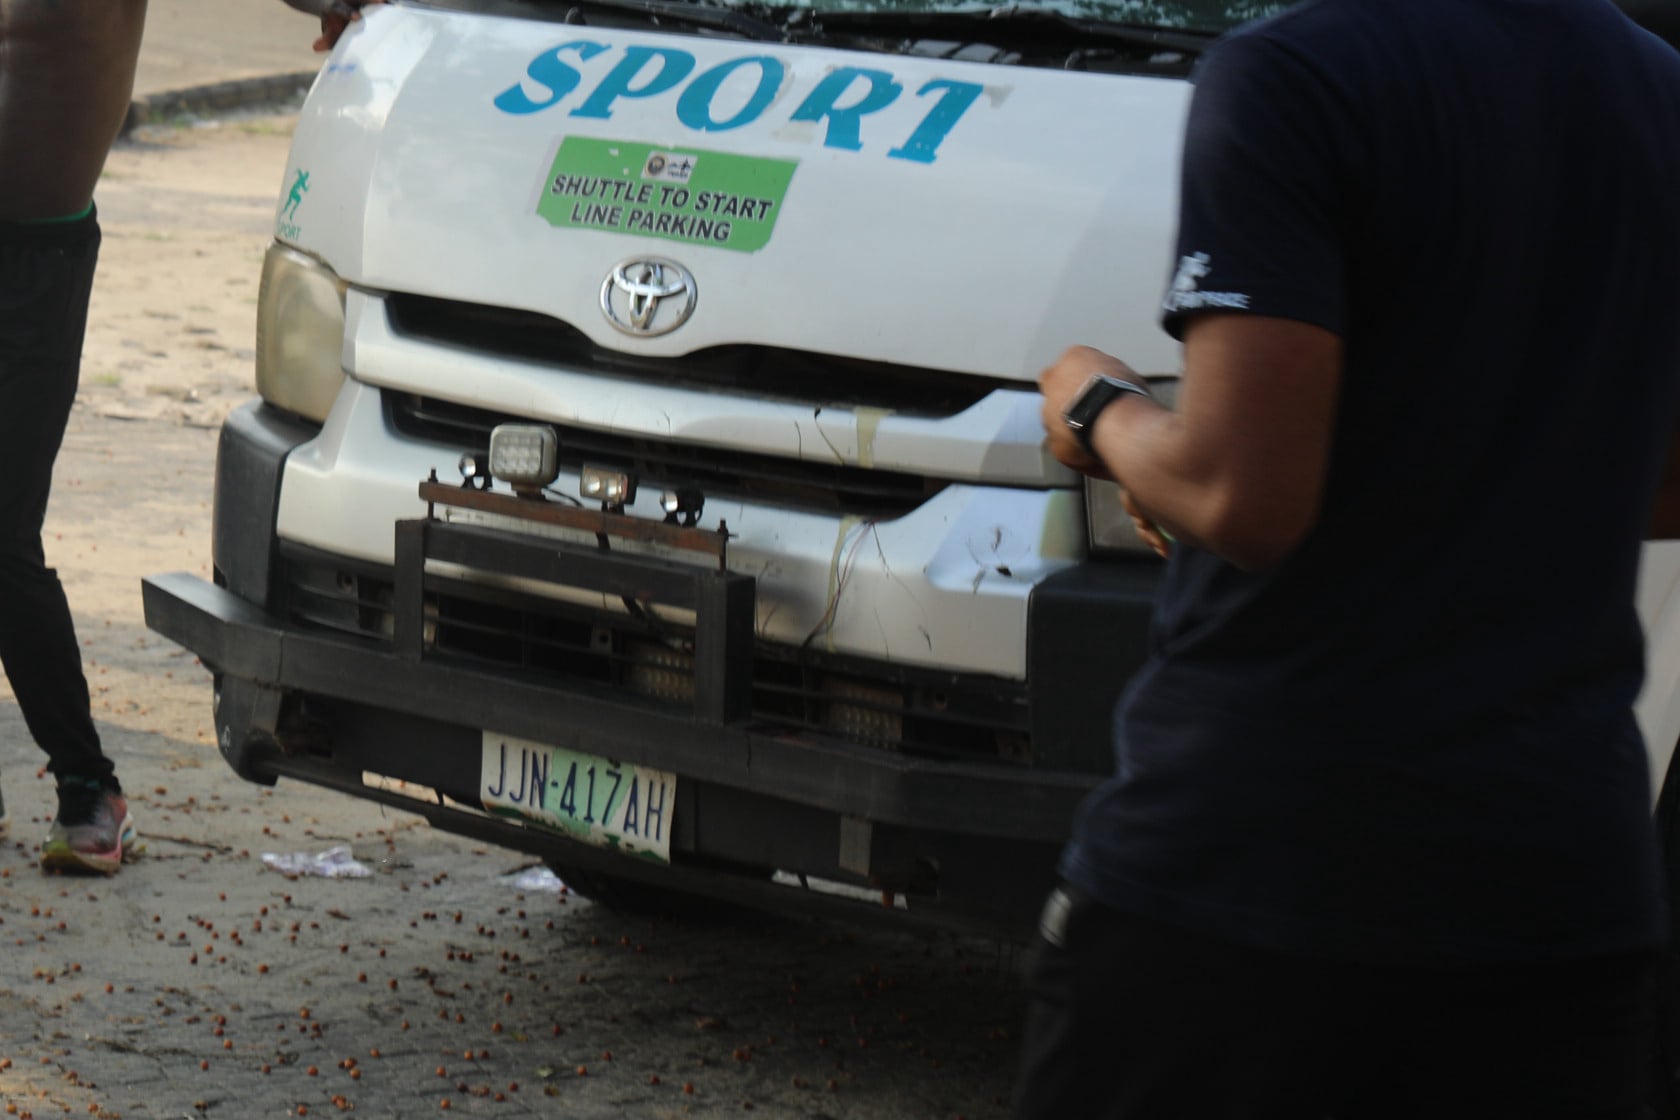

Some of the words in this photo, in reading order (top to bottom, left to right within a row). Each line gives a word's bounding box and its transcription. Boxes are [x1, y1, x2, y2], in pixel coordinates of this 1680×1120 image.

[494, 39, 985, 164] SPORT
[551, 173, 653, 205] SHUTTLE
[659, 185, 690, 208] TO
[695, 191, 773, 222] START
[570, 202, 623, 227] LINE
[627, 210, 731, 243] PARKING
[488, 743, 665, 841] JJN-417AH
